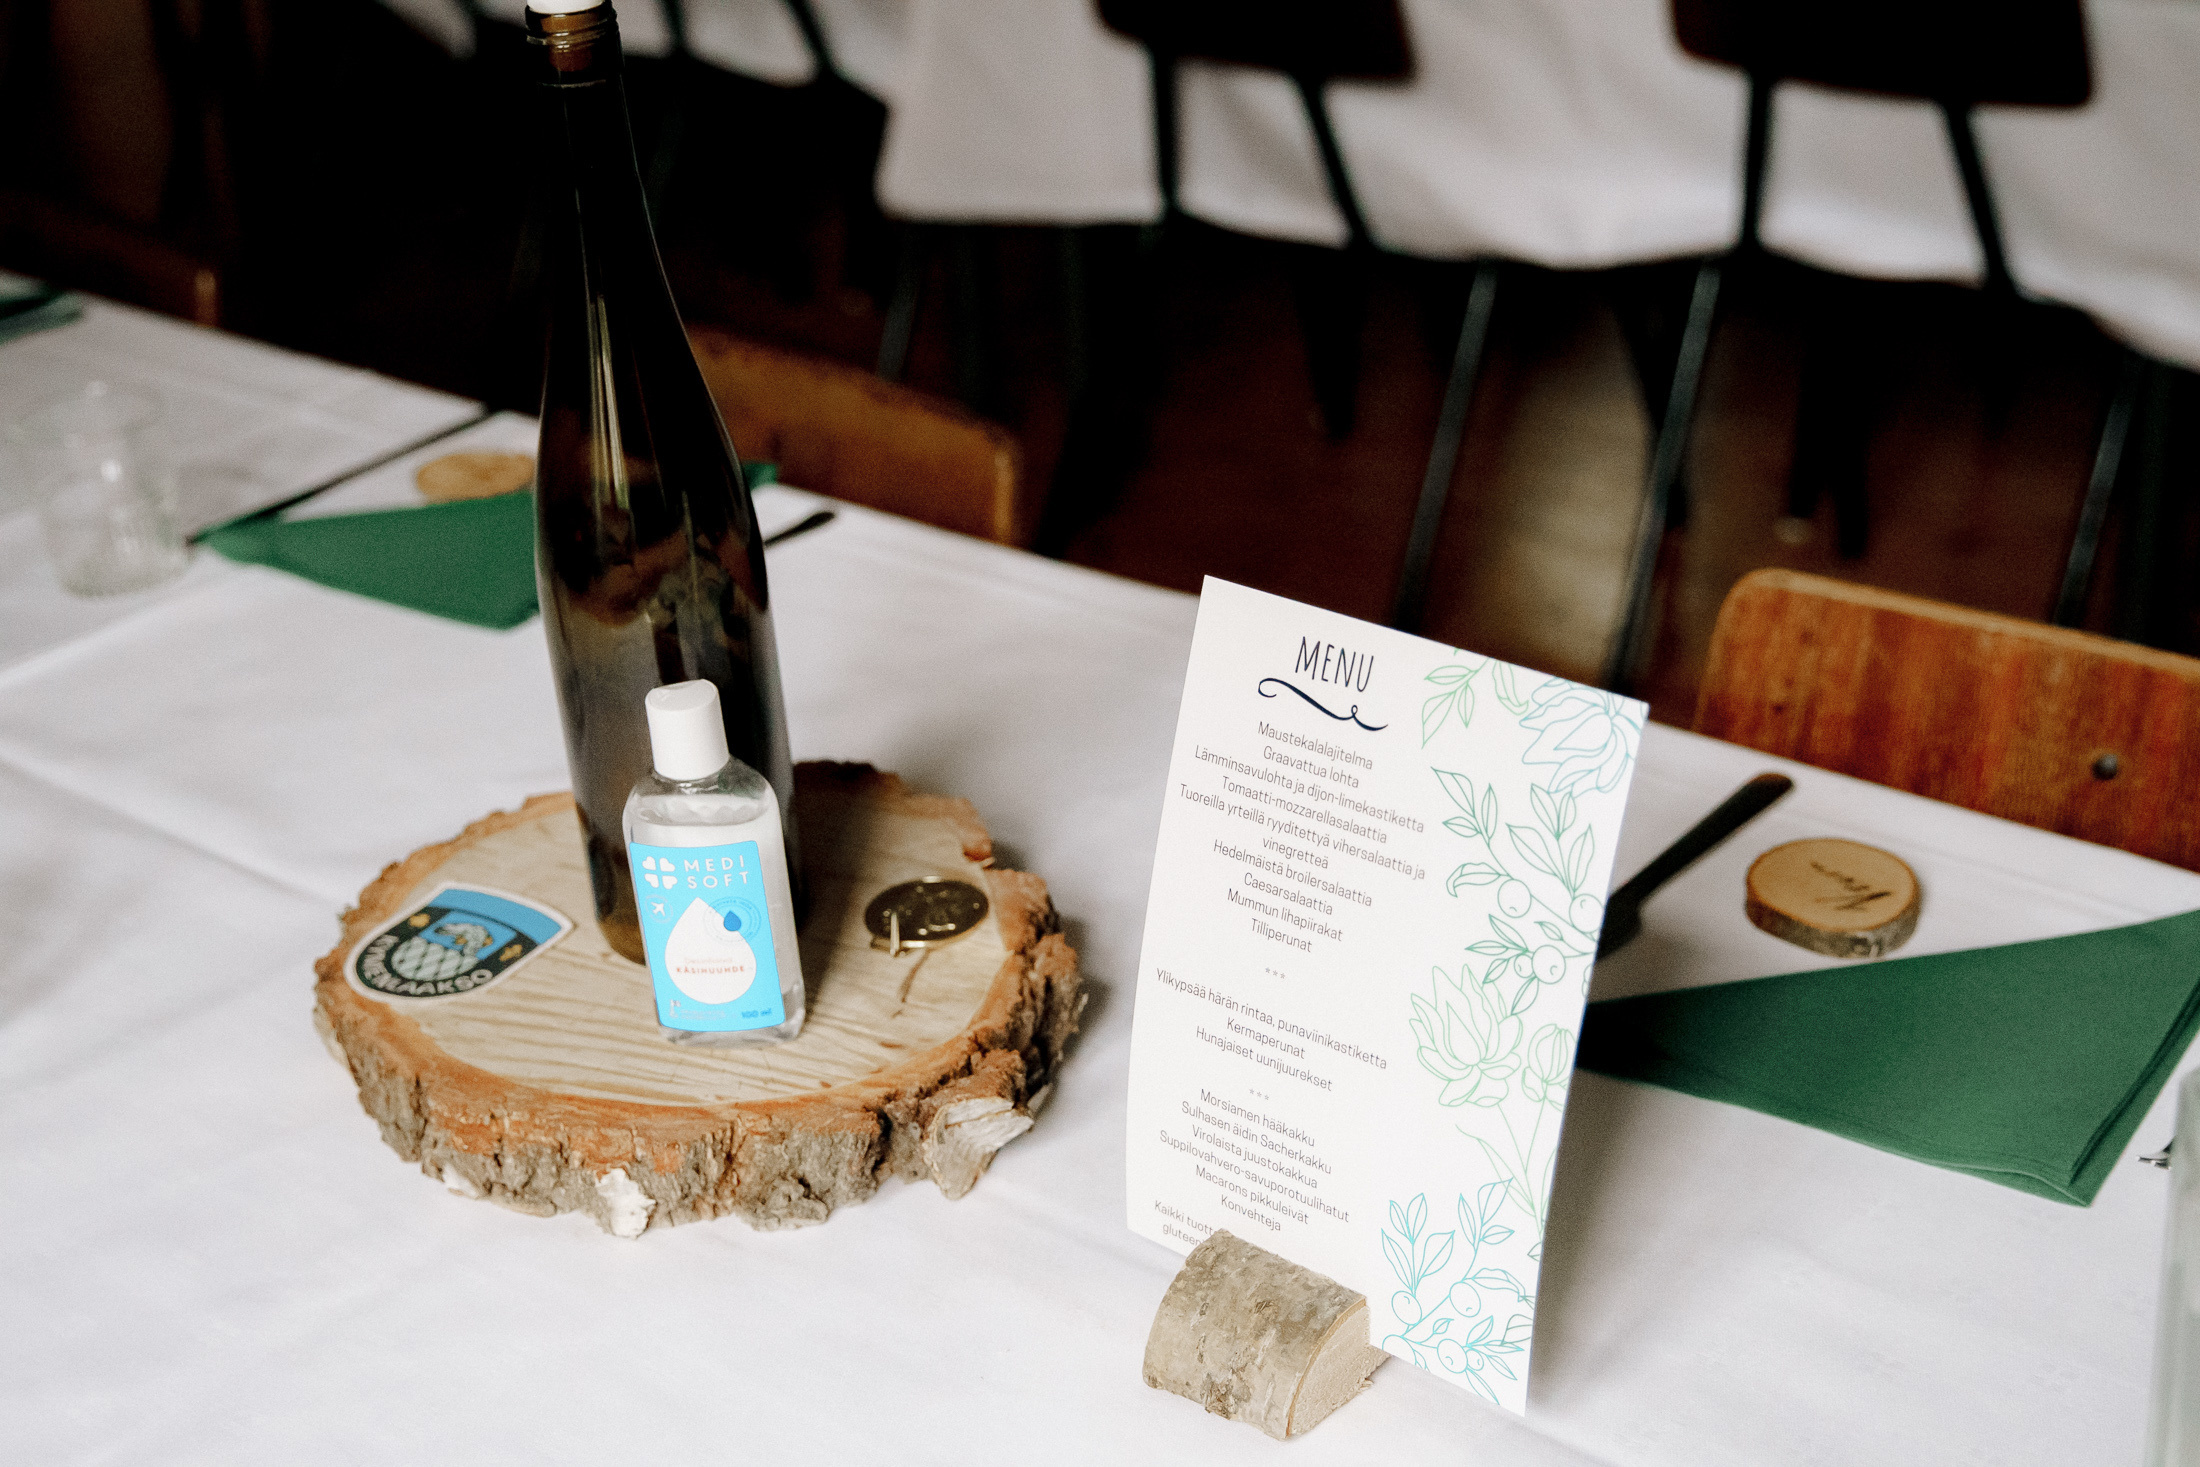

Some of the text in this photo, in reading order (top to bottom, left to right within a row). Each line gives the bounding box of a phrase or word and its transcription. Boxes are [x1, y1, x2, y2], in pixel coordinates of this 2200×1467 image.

[1294, 636, 1374, 692] MENU
[1258, 721, 1373, 770] Maustekalalajitelma
[1263, 745, 1359, 788] Graavattua lohta
[1195, 745, 1424, 833] Lämminsavulohta ja dijon-limekastiketta
[1222, 775, 1387, 843] Tomaatti-mozzarellasalaattia
[1180, 783, 1425, 881] Tuoreilla yrteillä ryyditettyä vihersalaattia ja
[1263, 837, 1329, 869] vinegretteä
[683, 855, 745, 873] MEDI
[687, 871, 749, 890] SOFT
[1213, 839, 1372, 907] Hedelmäistä broilersalaattia
[1227, 888, 1343, 942] Mummun lihapiirakat
[1244, 872, 1333, 915] Caesarsalaattia
[1252, 918, 1312, 953] Tilliperunat
[1156, 967, 1387, 1070] Ylikypsää härän rintaa, punaviinikastiketta
[1227, 1017, 1305, 1059] Kermaperunat
[1196, 1025, 1333, 1092] Hunajaiset uunijuurekset
[1181, 1101, 1332, 1175] Sulhasen äidin Sacherkakku
[1200, 1088, 1315, 1147] Morsiamen hääkakku
[1160, 1130, 1350, 1223] Suppilovahvero-savuporotuulihatut
[1192, 1124, 1318, 1189] Virolaista juustokakkua
[1154, 1200, 1214, 1236] Kaikki tuott
[1195, 1164, 1309, 1225] Macarons pikkuleivät
[1221, 1194, 1281, 1232] Konvehteja
[1163, 1224, 1203, 1246] gluteen
